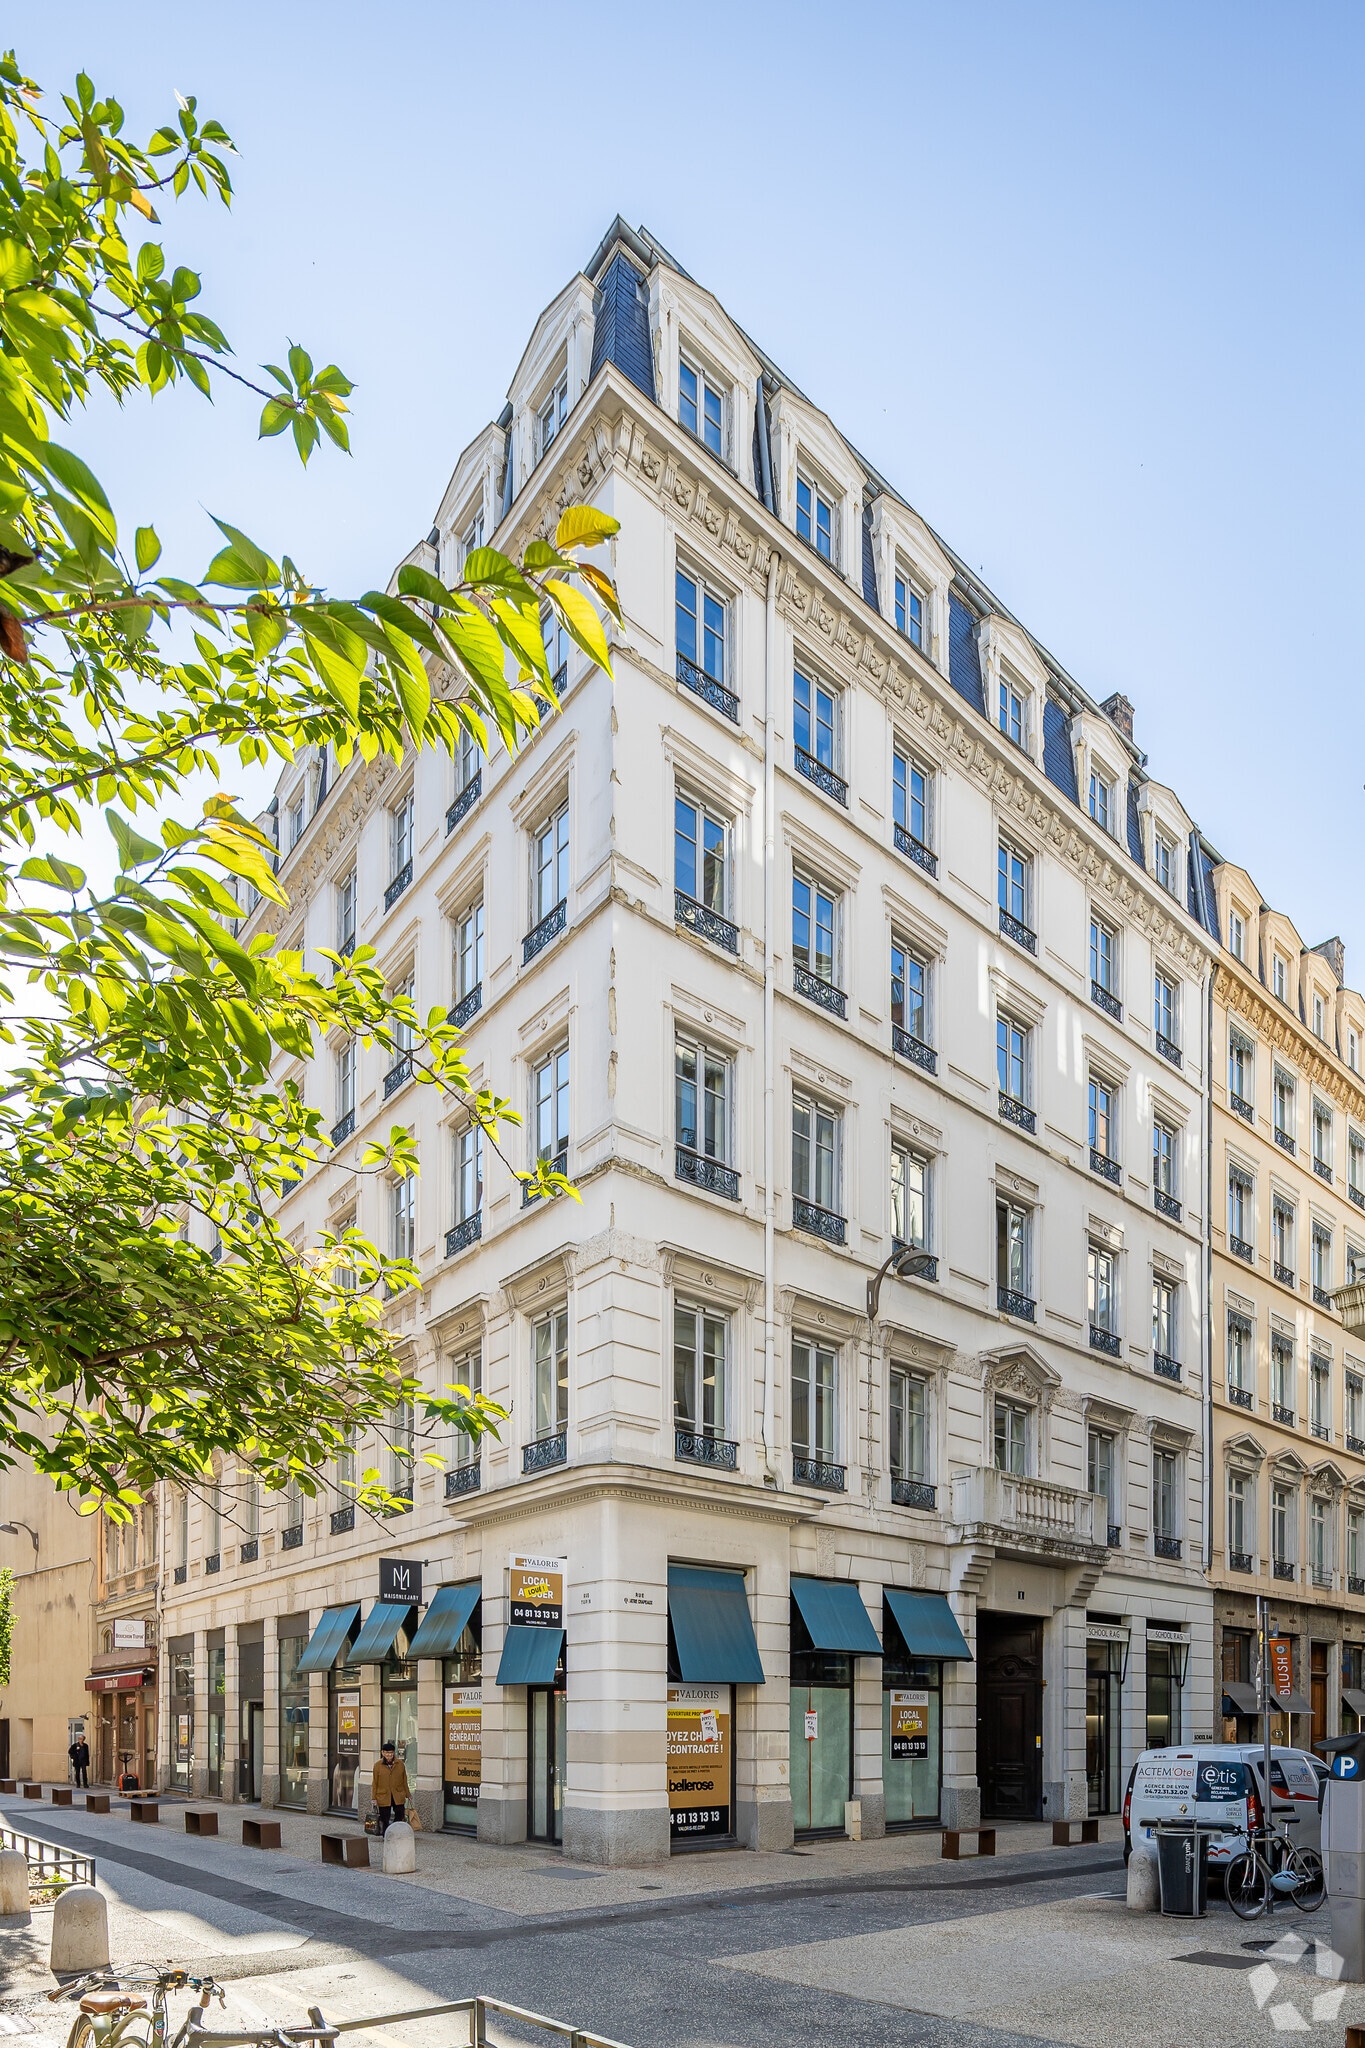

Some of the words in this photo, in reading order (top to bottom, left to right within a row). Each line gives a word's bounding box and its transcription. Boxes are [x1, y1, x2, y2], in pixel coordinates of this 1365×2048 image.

[527, 1558, 559, 1568] VALORIS
[522, 1575, 551, 1587] LOCAL
[518, 1587, 525, 1597] A
[514, 1608, 524, 1617] 04
[524, 1609, 533, 1618] 81
[533, 1610, 542, 1618] 13
[542, 1611, 550, 1619] 13
[551, 1611, 559, 1620] 13
[1088, 1627, 1108, 1638] SCHOOL
[1155, 1630, 1173, 1639] SCHOOL
[1277, 1657, 1291, 1695] BLUSH
[462, 1691, 482, 1700] VALOR
[680, 1689, 720, 1699] VALORIS
[900, 1710, 920, 1719] LOCAL
[449, 1722, 462, 1731] POUR
[462, 1723, 481, 1731] TOUTES
[449, 1730, 482, 1742] GÉNÉRATIO
[666, 1731, 689, 1742] OYEZ
[666, 1741, 719, 1754] ÉCONTRACTÉ
[907, 1742, 914, 1750] 13
[913, 1742, 920, 1750] 13
[919, 1742, 926, 1750] 13
[1137, 1767, 1195, 1777] ACTEM'Otel
[1340, 1756, 1355, 1777] P
[1205, 1769, 1237, 1784] etis
[452, 1785, 460, 1795] 04
[669, 1779, 714, 1792] bellerose
[676, 1813, 687, 1825] 81
[688, 1812, 698, 1823] 13
[699, 1811, 709, 1823] 13
[710, 1810, 720, 1822] 13
